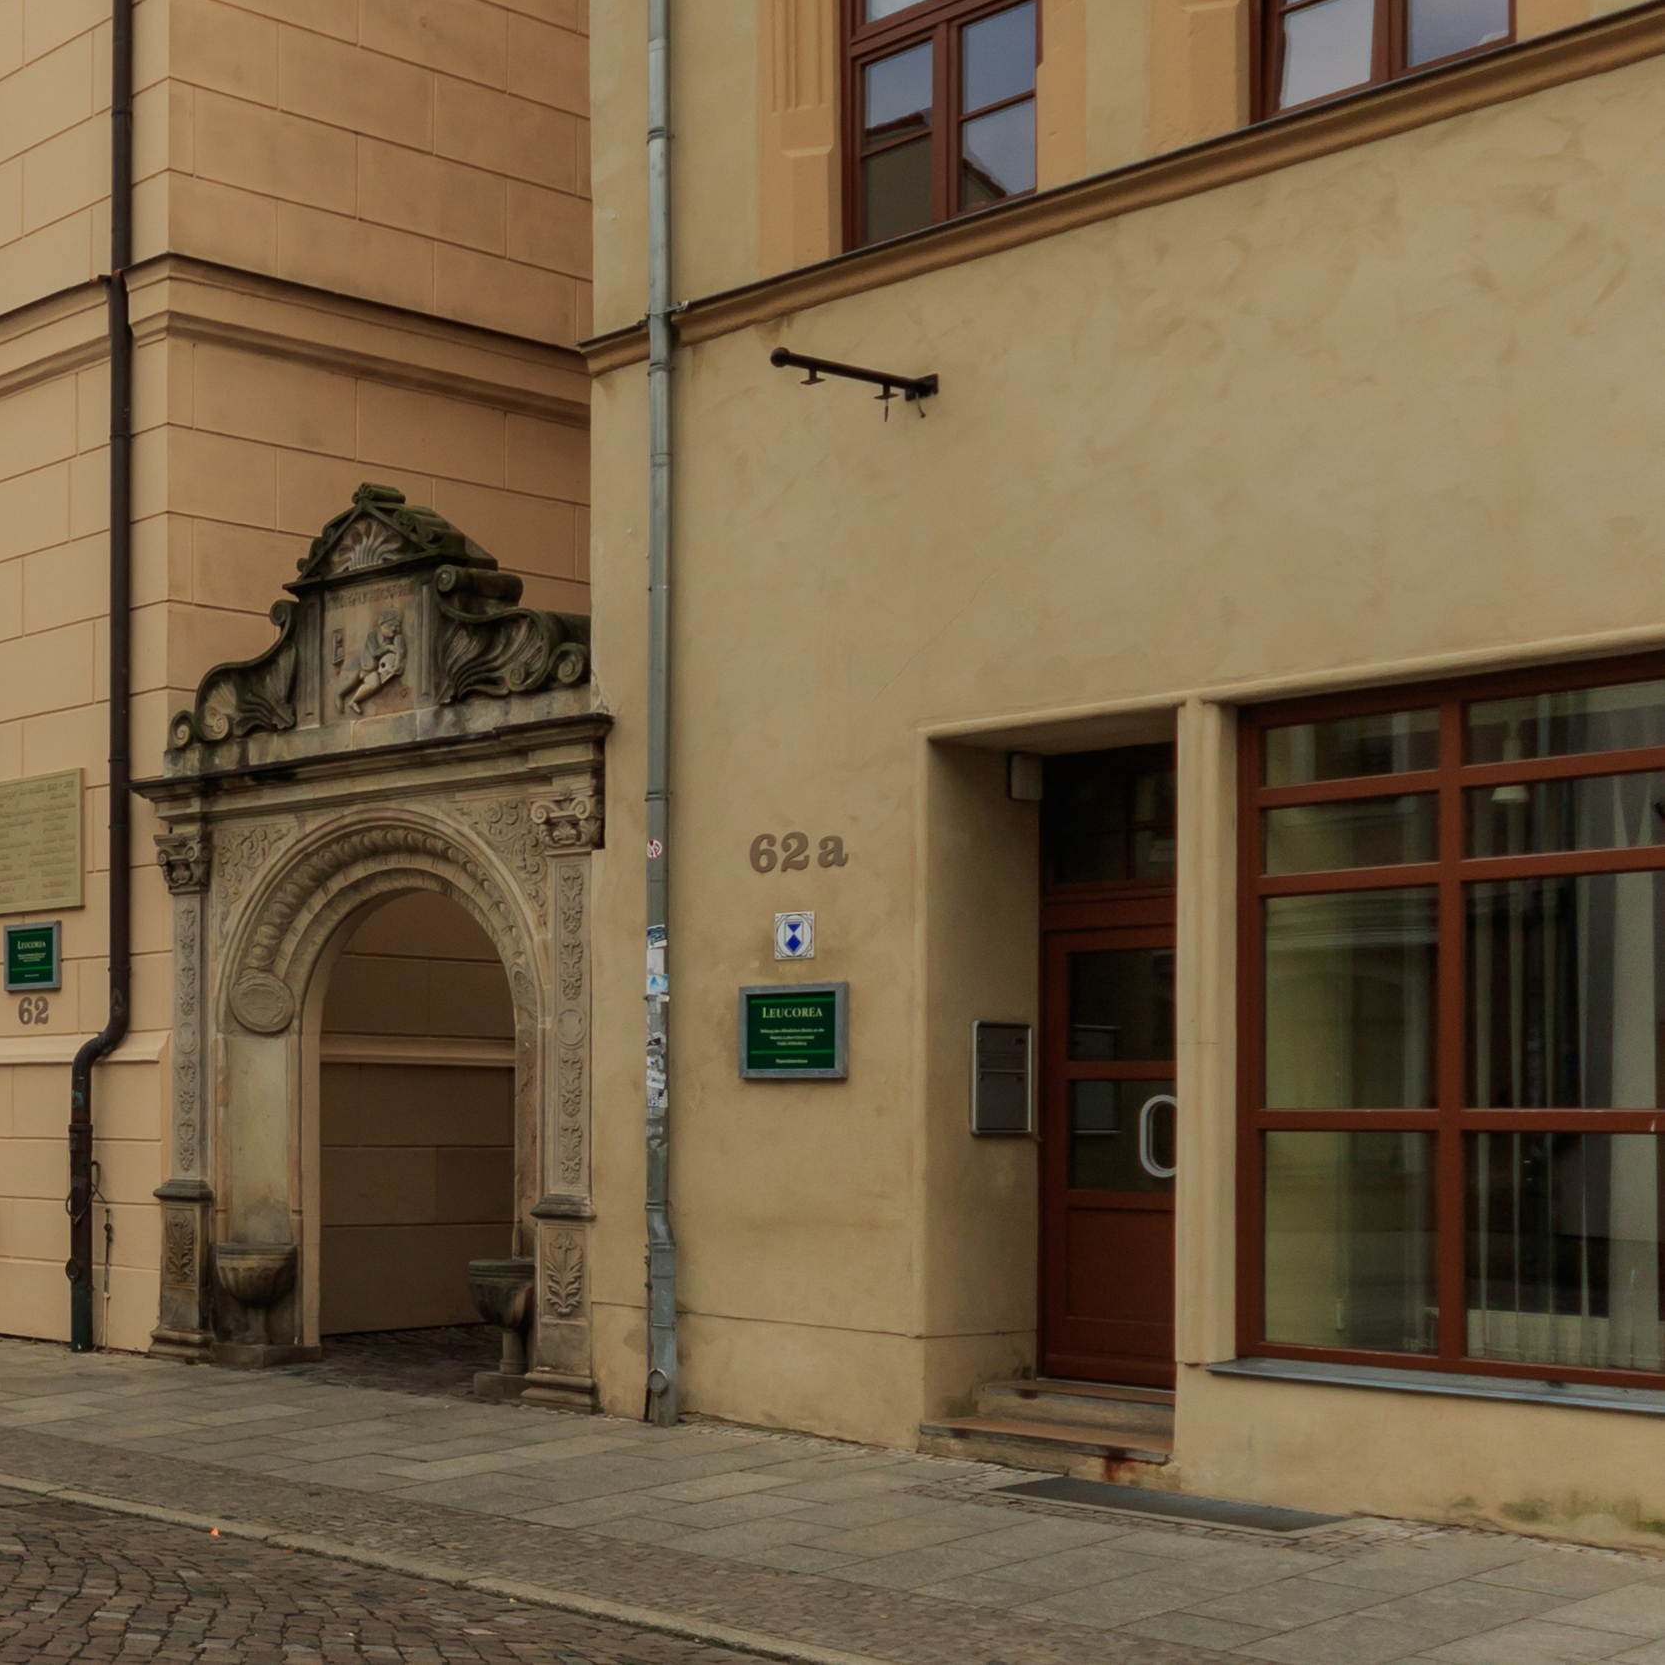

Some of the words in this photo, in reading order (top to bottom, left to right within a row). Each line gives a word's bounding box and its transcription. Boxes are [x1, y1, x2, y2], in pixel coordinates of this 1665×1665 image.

[749, 831, 849, 873] 62a
[18, 996, 50, 1025] 62
[762, 1007, 823, 1018] LEUCOREA
